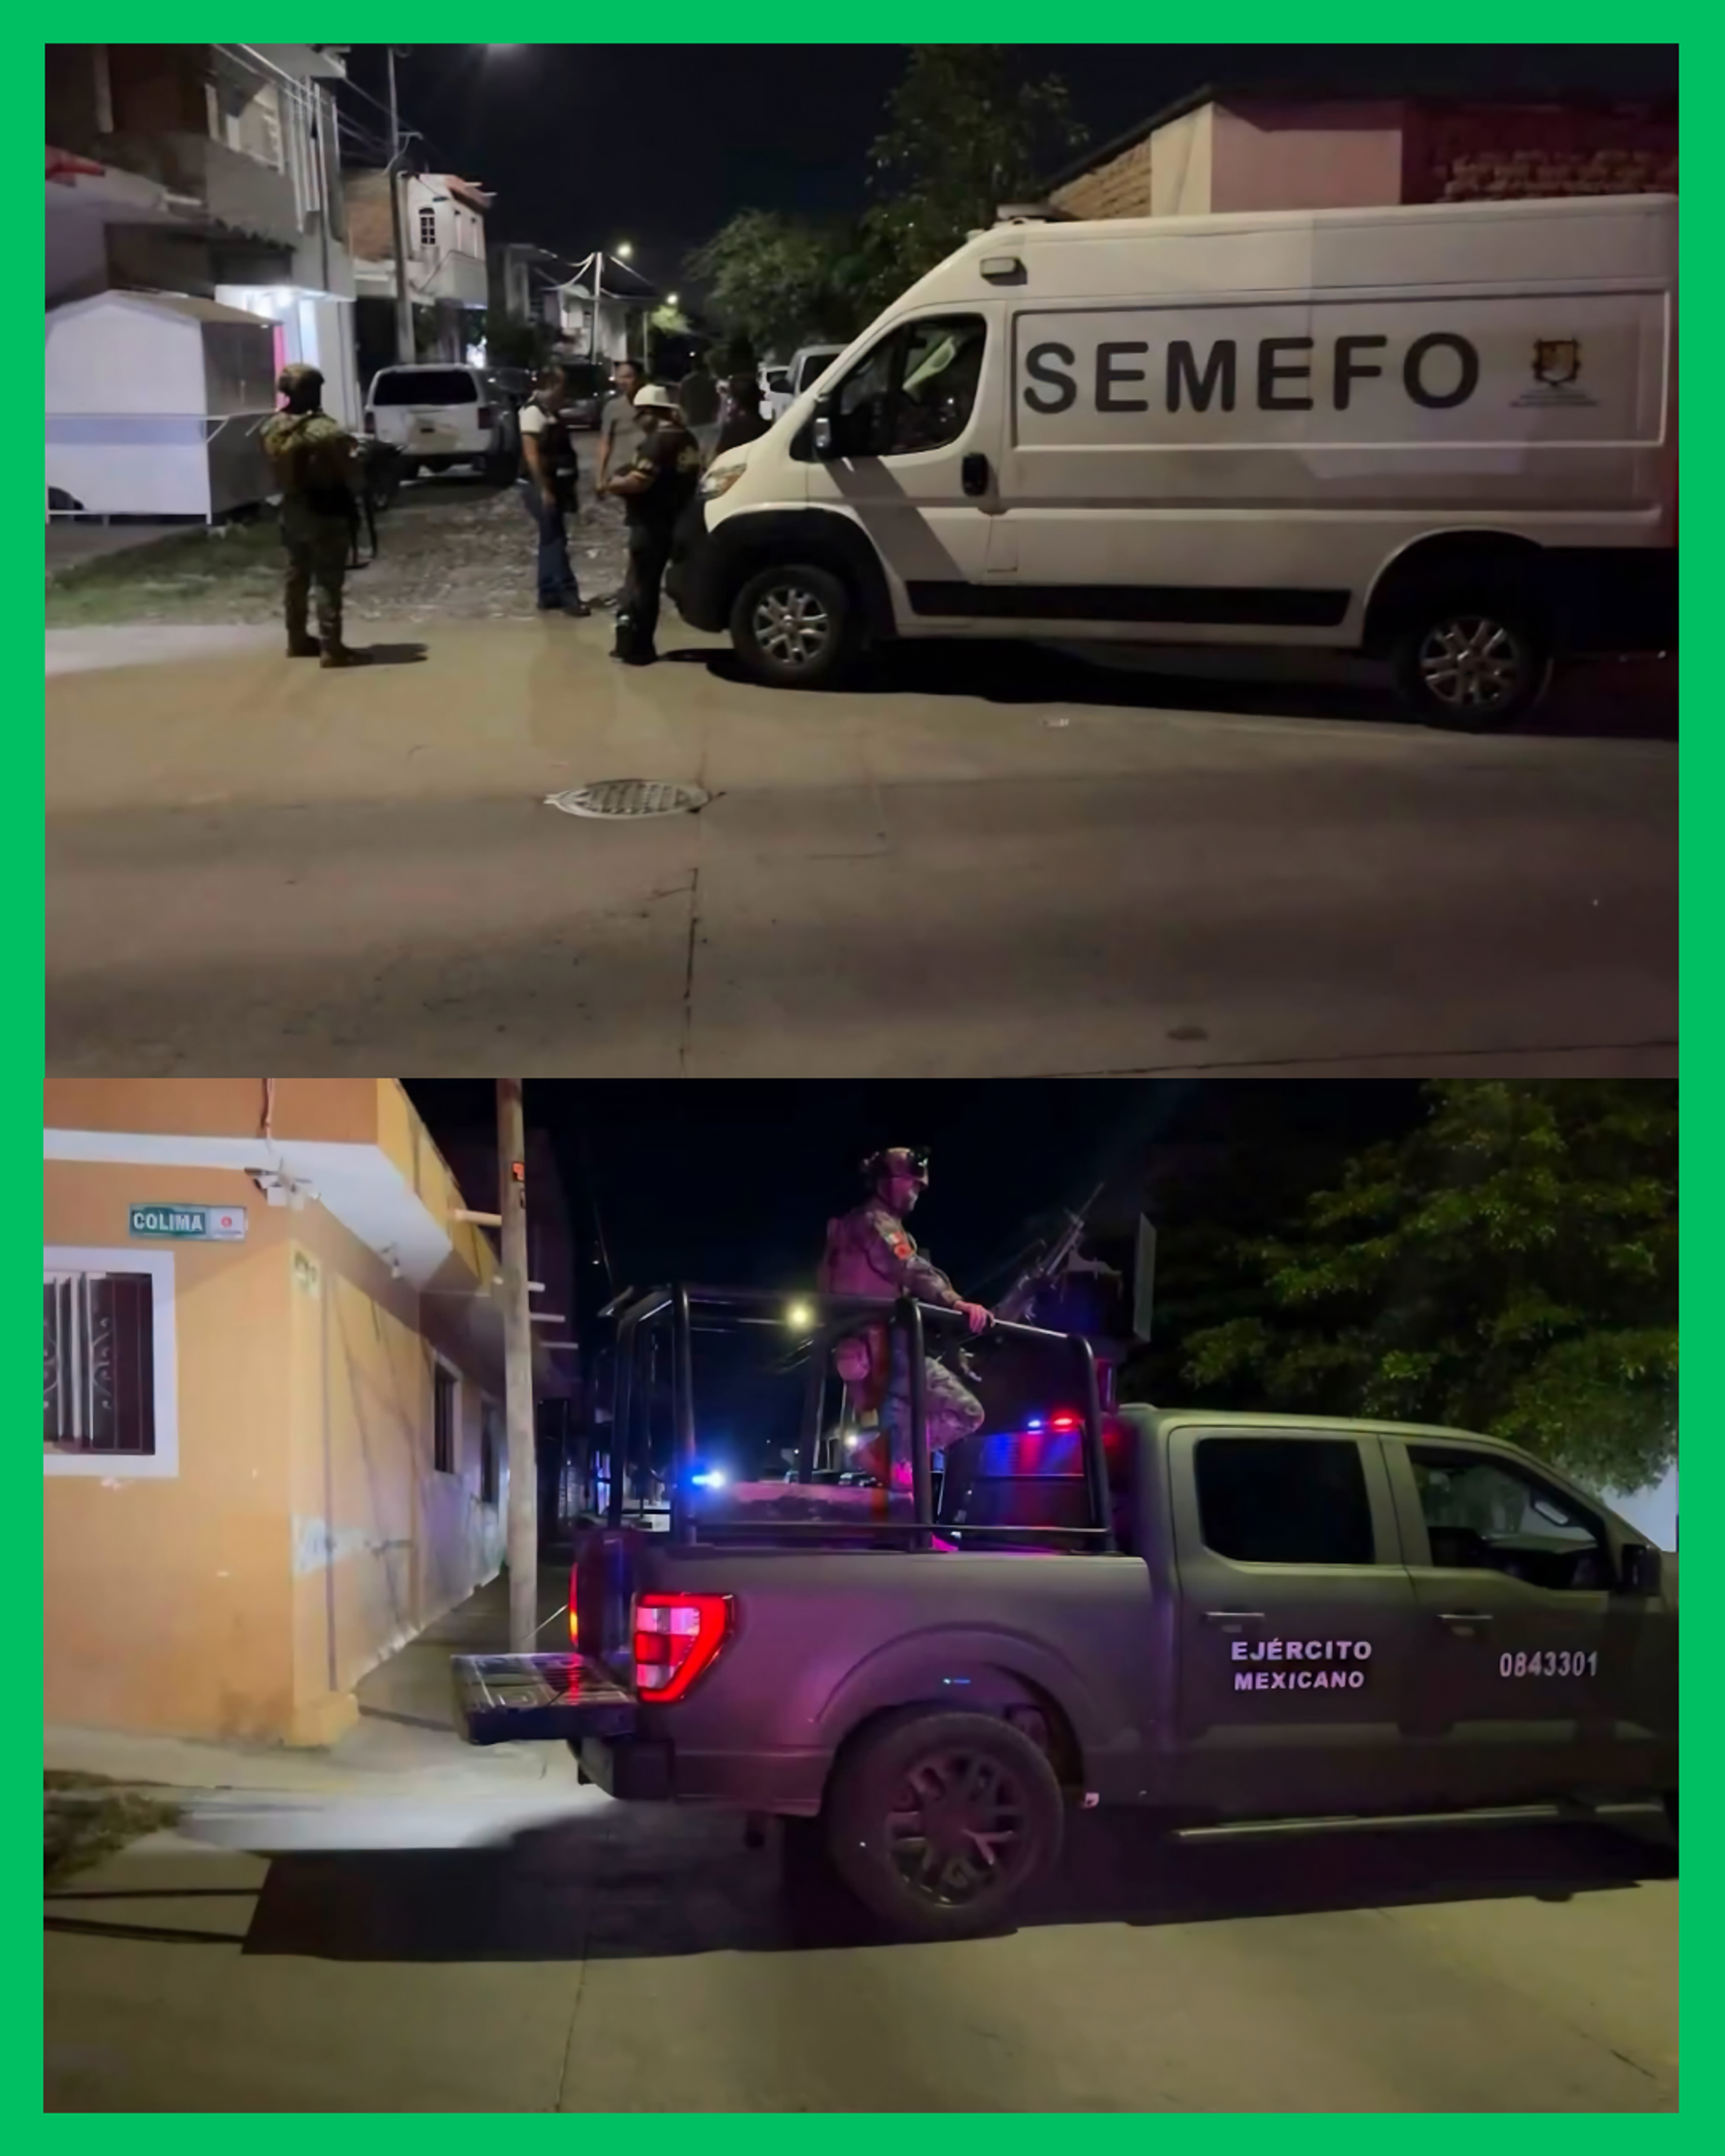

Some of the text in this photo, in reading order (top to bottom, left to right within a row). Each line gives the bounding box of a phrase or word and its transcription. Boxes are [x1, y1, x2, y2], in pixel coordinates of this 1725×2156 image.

[1023, 331, 1481, 415] SEMEFO
[133, 1212, 202, 1230] COLIMA
[1231, 1638, 1372, 1660] EJÉRCITO
[1499, 1651, 1598, 1677] 0843301
[1234, 1671, 1364, 1690] MEXICANO
